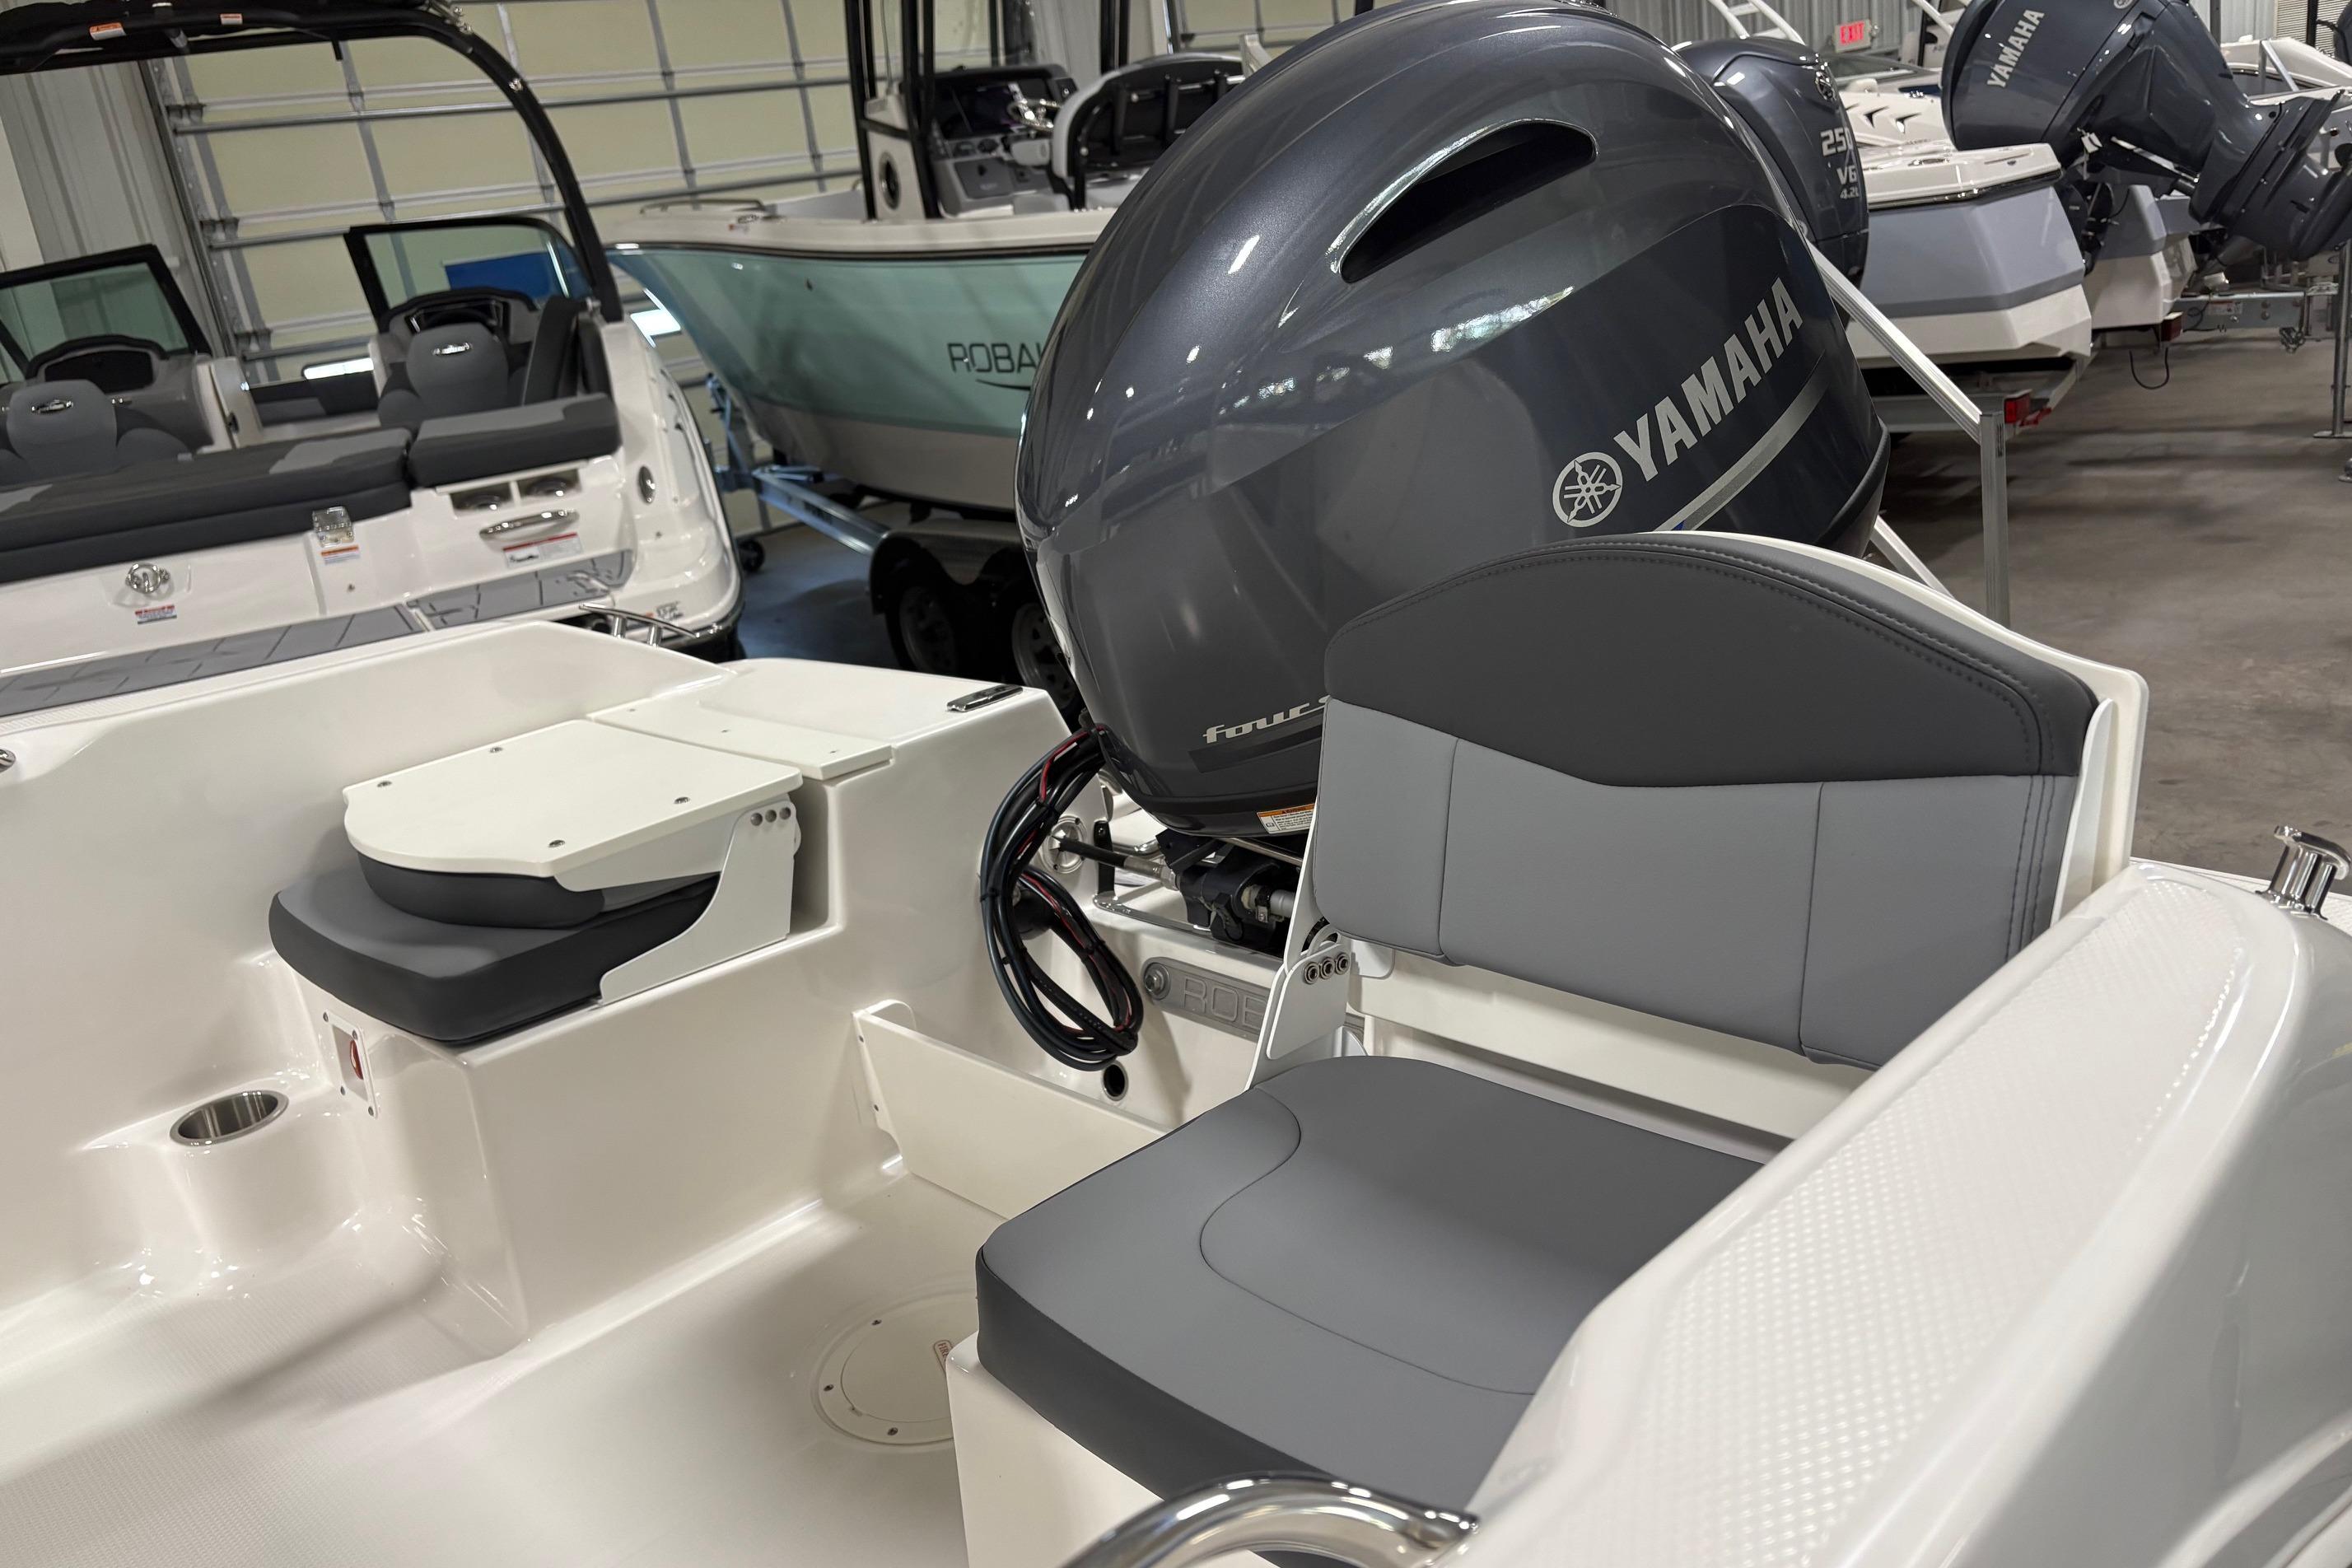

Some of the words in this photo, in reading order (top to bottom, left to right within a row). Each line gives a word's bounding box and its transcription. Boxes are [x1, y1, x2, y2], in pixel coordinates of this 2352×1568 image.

[1840, 21, 1864, 44] EXIT
[1987, 10, 2045, 87] YAMAHA
[1820, 127, 1854, 156] 250
[1836, 166, 1858, 184] V6
[1613, 277, 1804, 482] YAMAHA
[1183, 976, 1269, 1029] ROB
